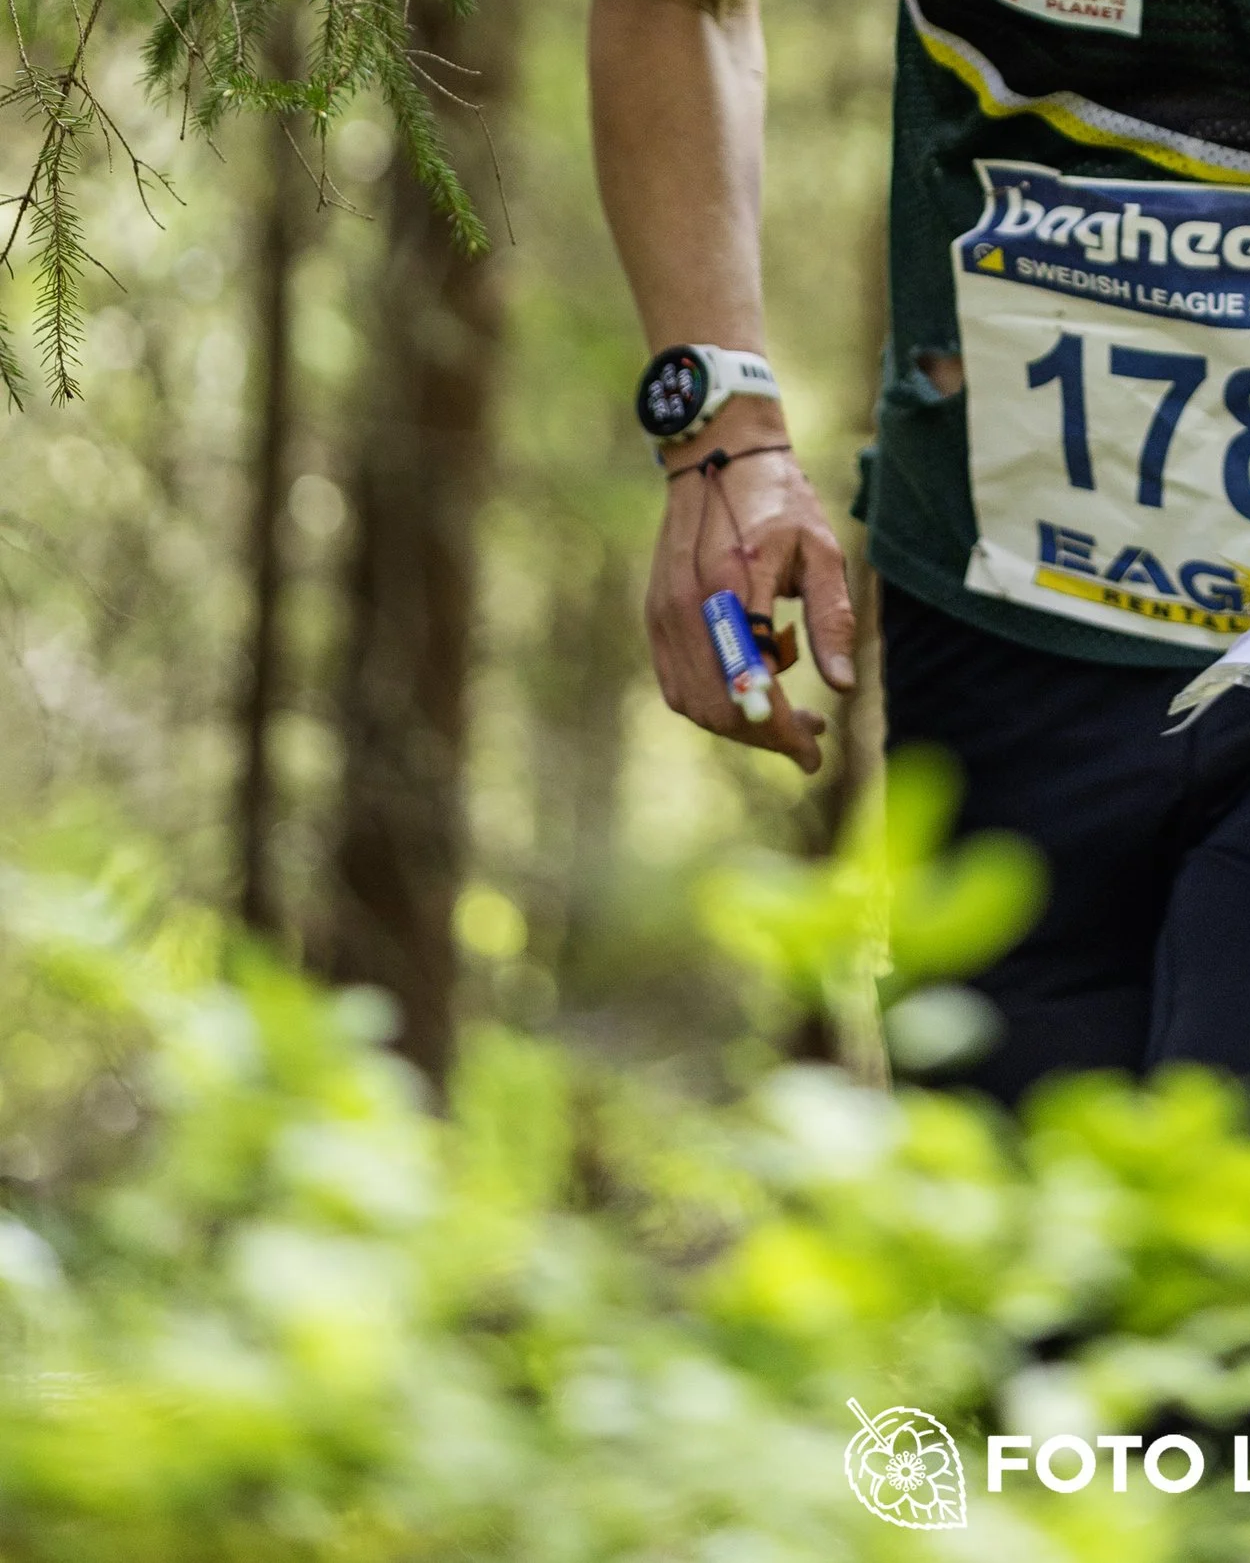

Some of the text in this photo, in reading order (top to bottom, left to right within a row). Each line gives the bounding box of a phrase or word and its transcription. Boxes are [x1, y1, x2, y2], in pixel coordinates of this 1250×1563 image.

[1015, 256, 1132, 300] SWEDISH
[1136, 283, 1244, 316] LEAGUE
[1102, 588, 1243, 632] RENTAL
